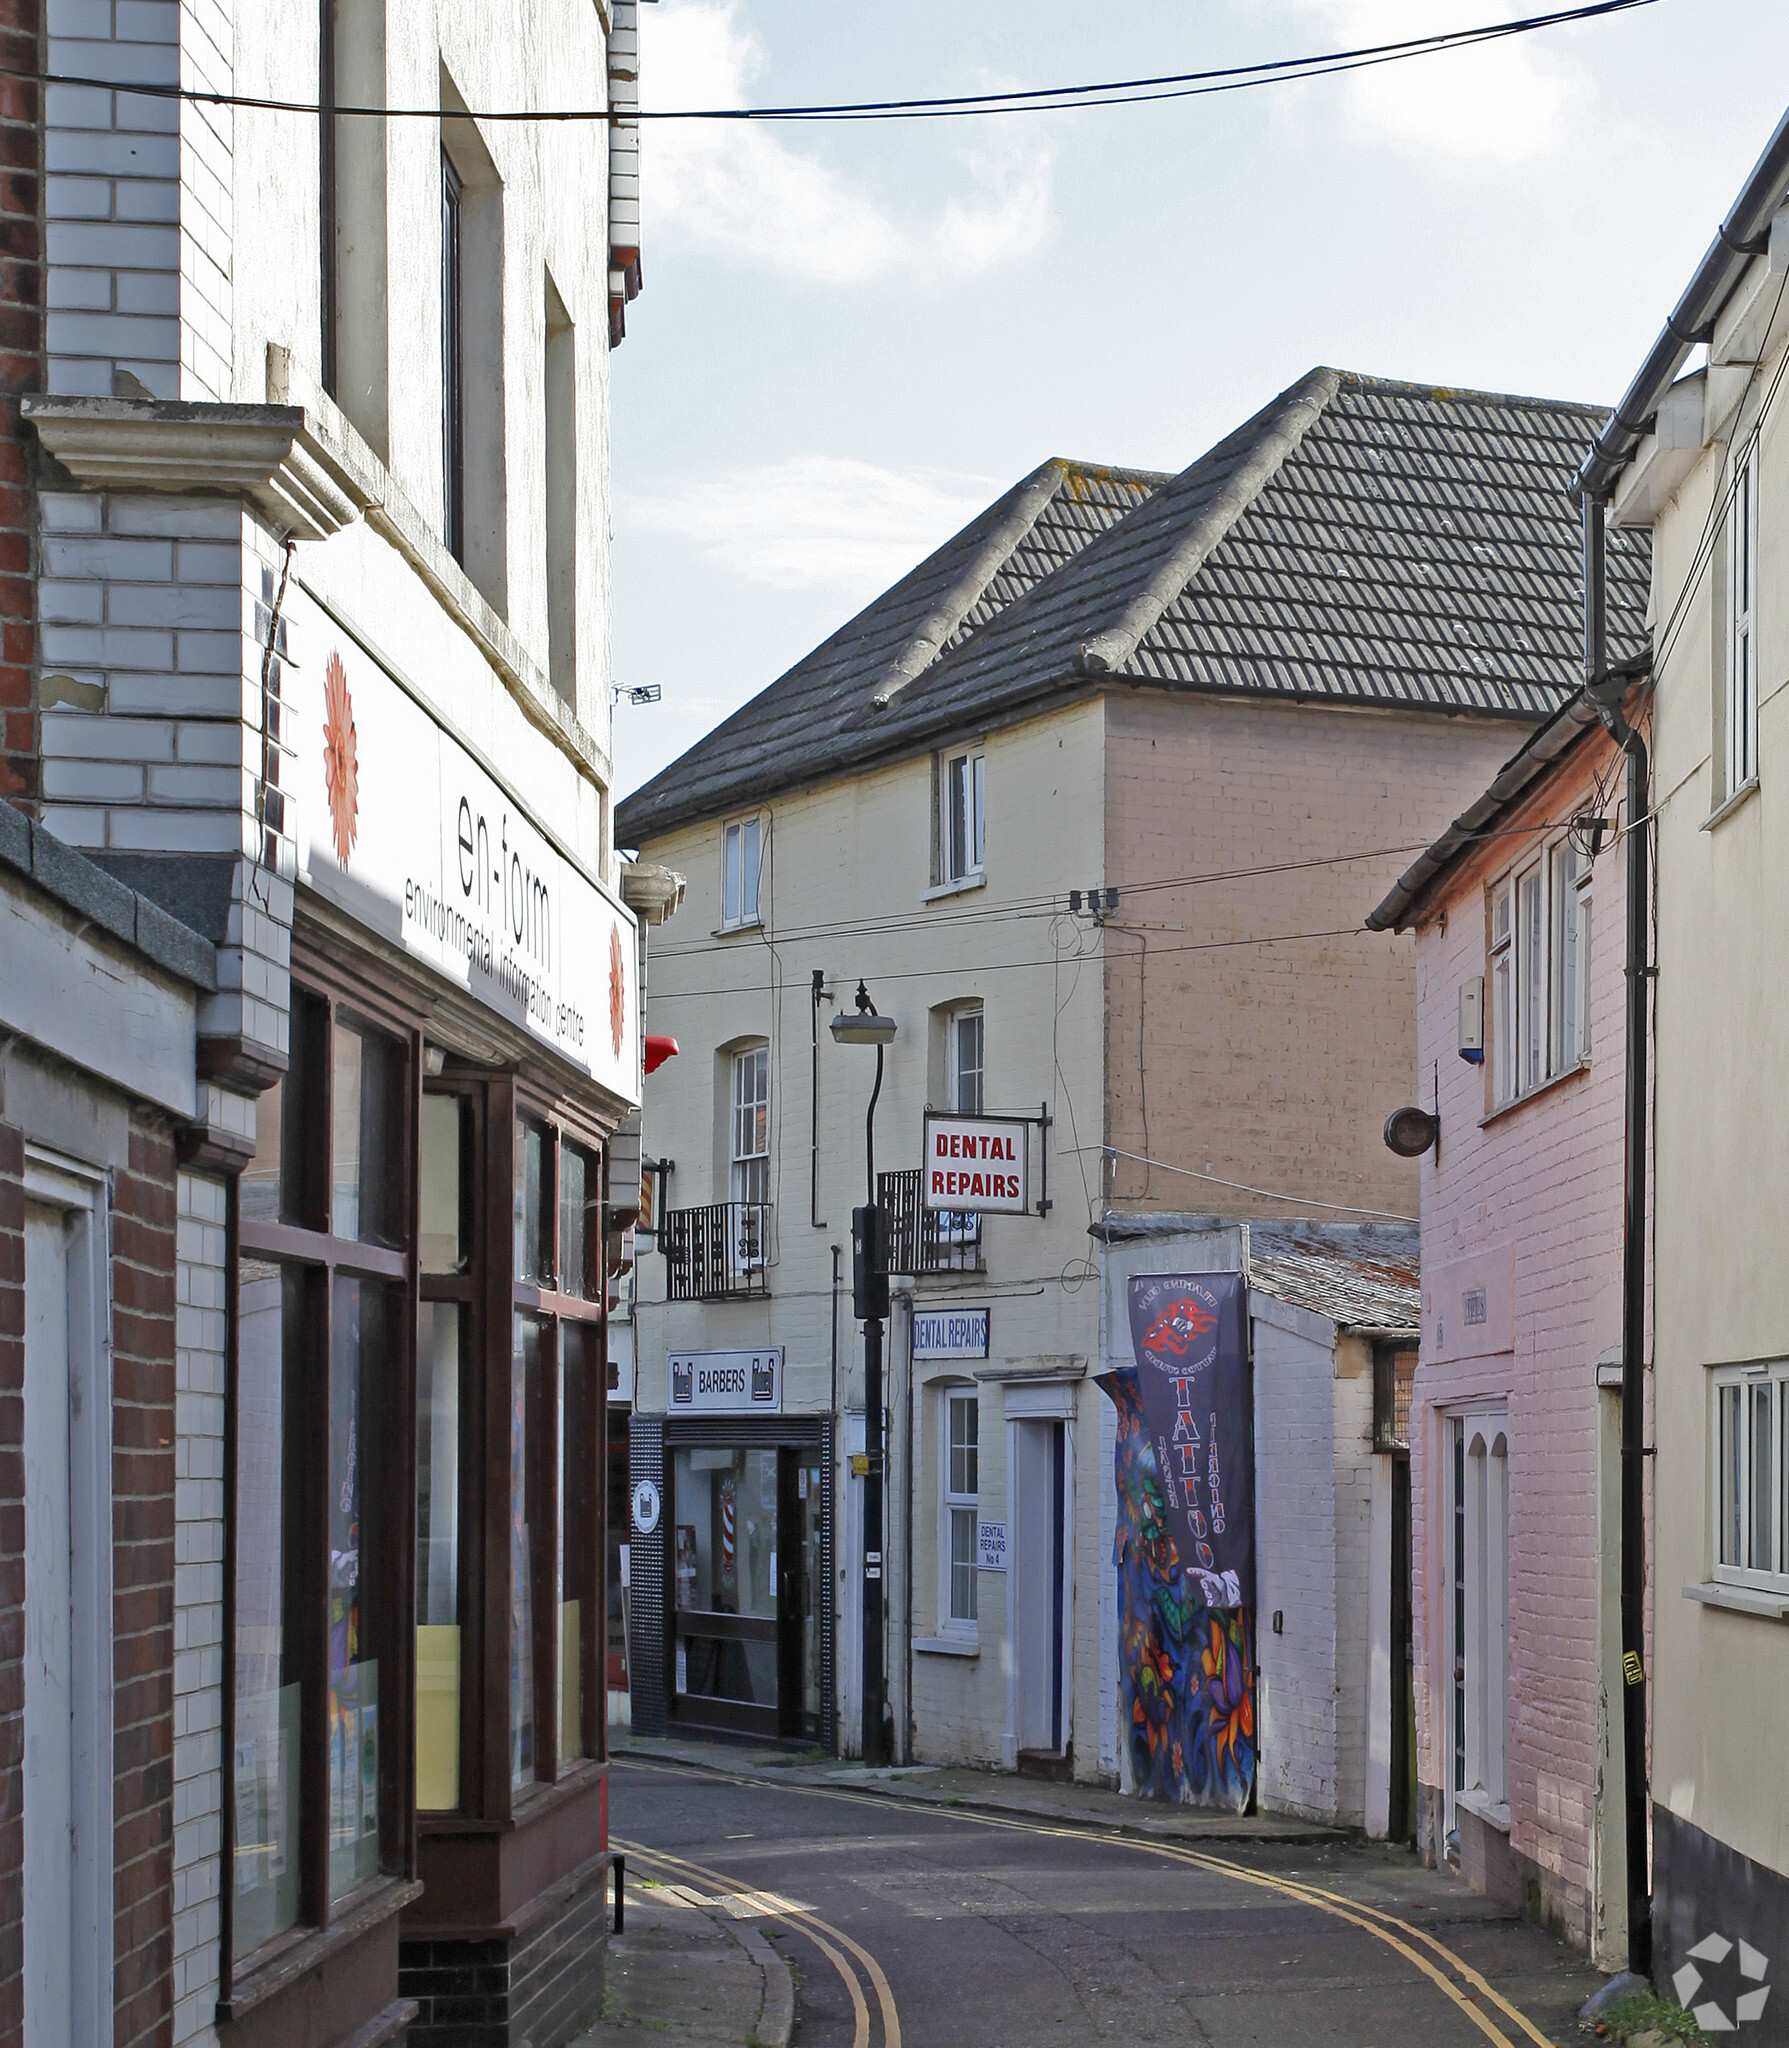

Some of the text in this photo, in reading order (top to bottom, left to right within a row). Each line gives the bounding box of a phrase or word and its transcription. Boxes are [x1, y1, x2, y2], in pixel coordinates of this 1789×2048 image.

[458, 796, 550, 973] en-form
[405, 878, 584, 1047] environmental information centre
[936, 1133, 1016, 1161] DENTAL
[932, 1170, 1019, 1198] REPAIRS
[914, 1317, 987, 1349] DENTAL REPAIRS
[699, 1369, 745, 1393] BARBERS
[980, 1539, 1006, 1552] REPAIRS
[981, 1526, 1005, 1538] DENTAL
